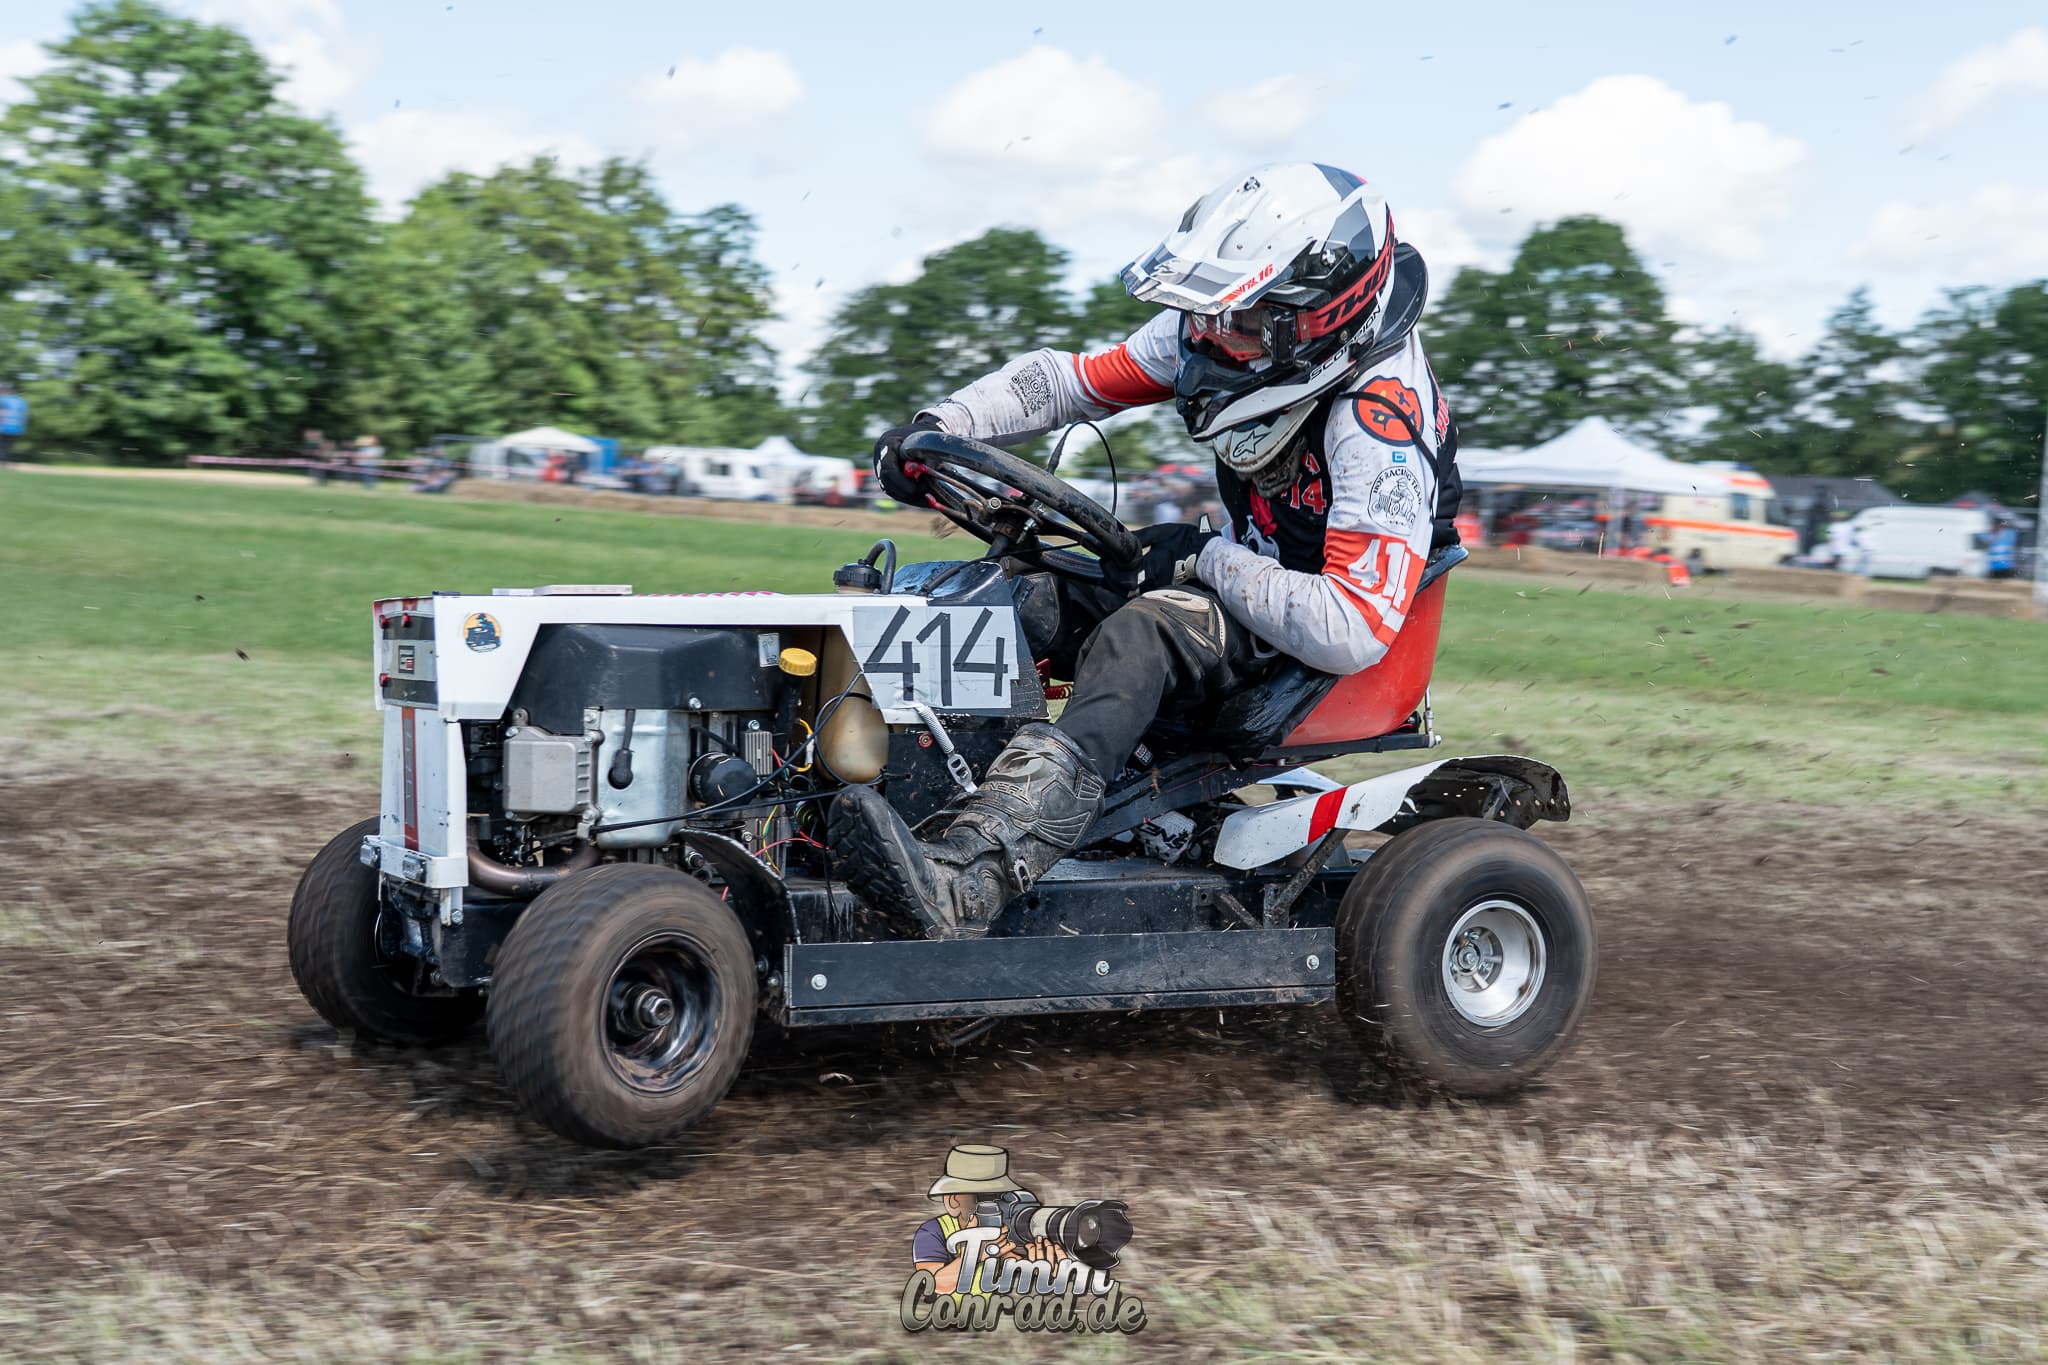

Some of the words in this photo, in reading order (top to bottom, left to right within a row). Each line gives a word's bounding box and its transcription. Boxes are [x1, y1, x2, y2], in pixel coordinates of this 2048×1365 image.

[1309, 303, 1382, 381] SCOPION
[1280, 473, 1327, 515] 14
[863, 605, 1008, 706] 414
